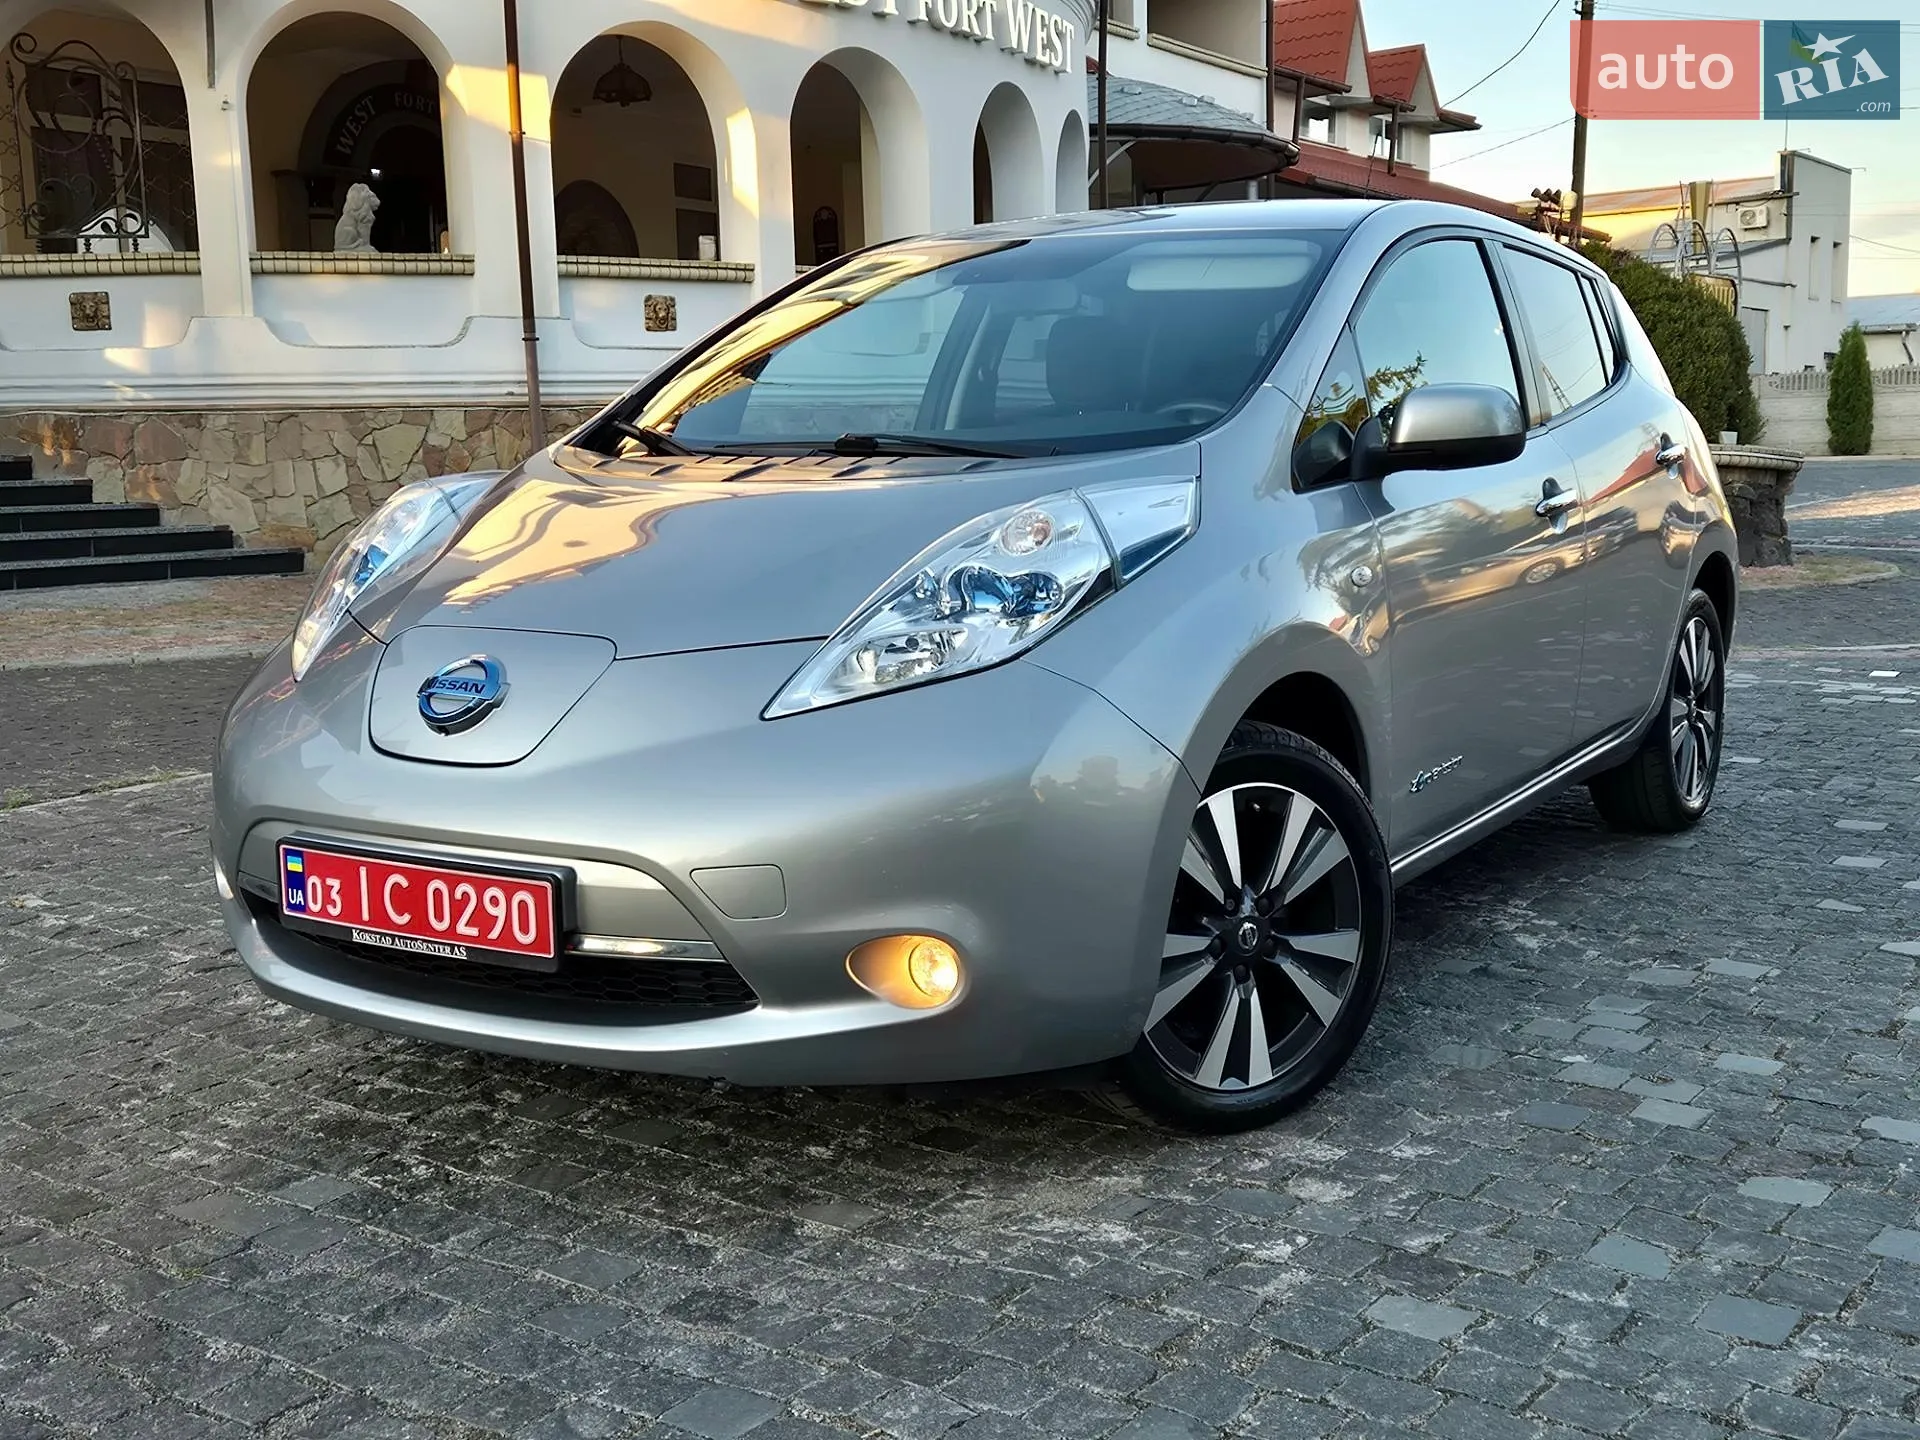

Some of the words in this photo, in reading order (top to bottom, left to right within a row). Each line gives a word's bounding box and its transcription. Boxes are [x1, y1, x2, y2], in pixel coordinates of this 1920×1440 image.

[908, 0, 997, 41] FORT
[1001, 0, 1075, 74] WEST
[337, 96, 376, 154] WEST
[394, 92, 435, 114] FORT
[427, 679, 485, 694] NISSAN
[289, 888, 304, 906] UA
[307, 875, 342, 917] 03
[359, 866, 412, 925] IC
[427, 879, 537, 945] 0290
[453, 945, 467, 957] AS
